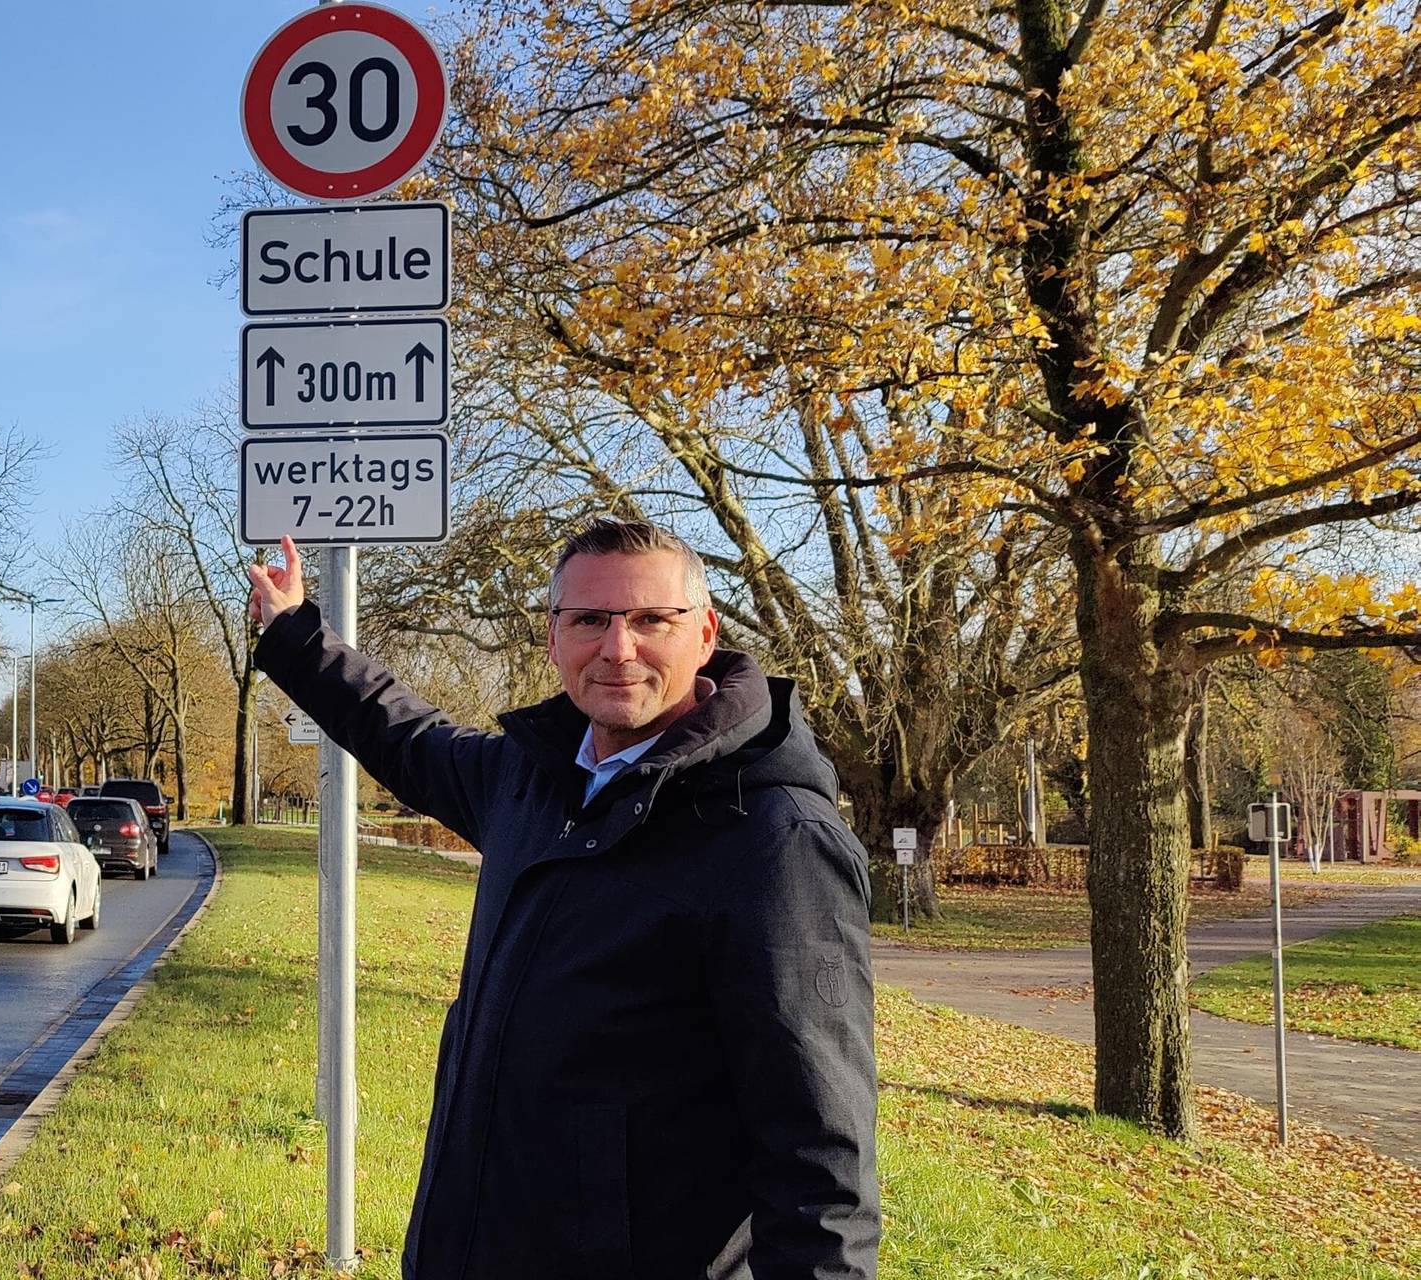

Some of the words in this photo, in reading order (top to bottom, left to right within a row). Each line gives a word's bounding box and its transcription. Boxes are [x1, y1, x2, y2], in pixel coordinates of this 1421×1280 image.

[286, 57, 400, 146] 30
[258, 236, 431, 285] Schule
[297, 361, 396, 403] 300m
[254, 452, 434, 491] werktags
[292, 494, 395, 527] 7-22h
